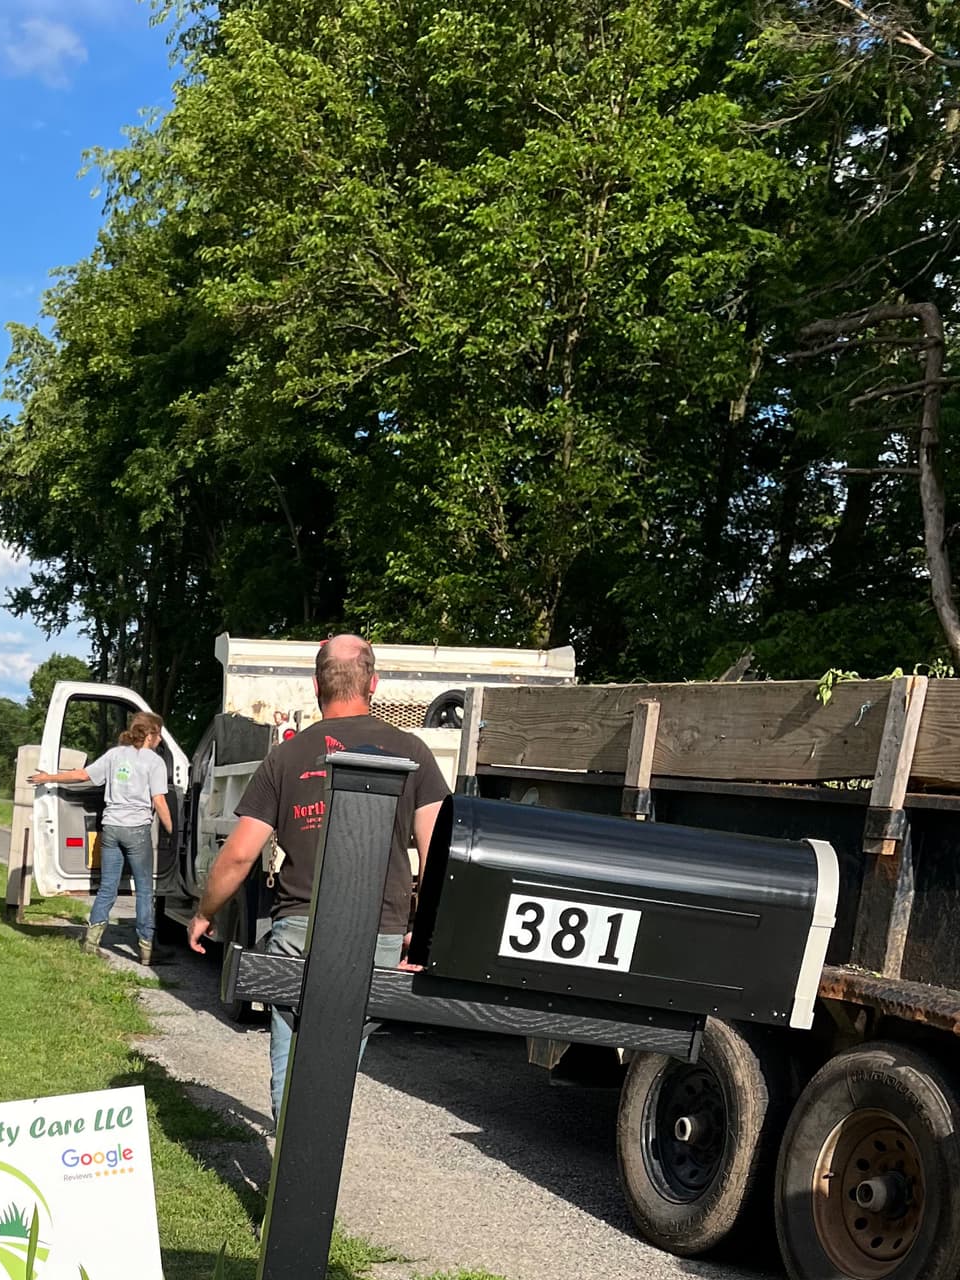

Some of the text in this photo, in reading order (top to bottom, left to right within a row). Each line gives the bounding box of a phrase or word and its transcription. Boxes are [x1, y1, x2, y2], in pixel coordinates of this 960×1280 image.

[509, 901, 623, 965] 381
[29, 1116, 86, 1139] Care
[94, 1105, 134, 1132] LLC
[61, 1144, 134, 1168] Google
[63, 1172, 93, 1182] Reviews
